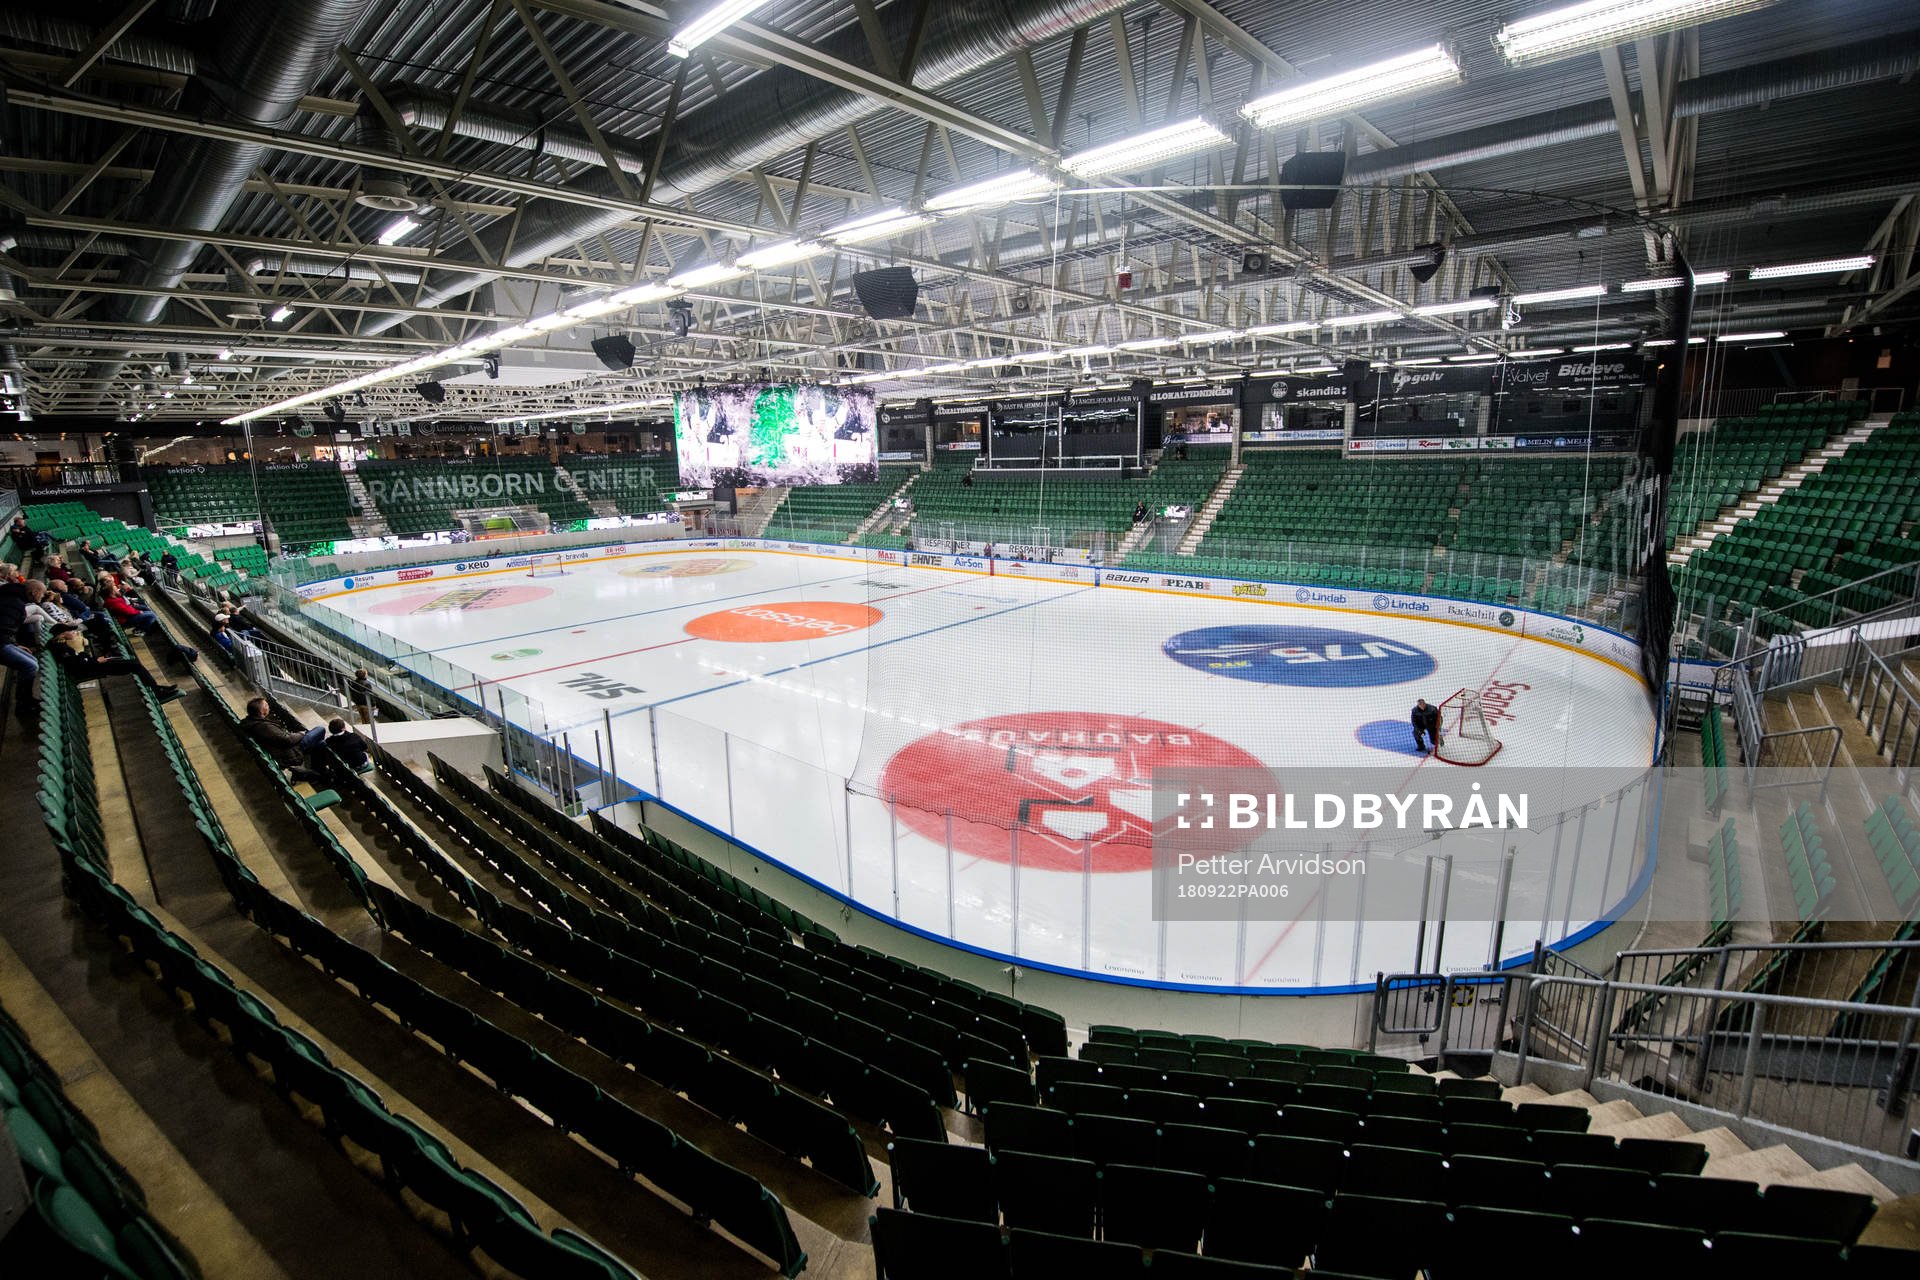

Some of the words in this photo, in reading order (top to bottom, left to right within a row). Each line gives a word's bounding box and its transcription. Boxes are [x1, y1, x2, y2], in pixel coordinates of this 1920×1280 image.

[1510, 368, 1550, 382] Valvet
[1558, 363, 1625, 377] Bildeve
[1157, 387, 1234, 401] LOKALTIDNINGEN
[437, 424, 465, 432] Lindab
[553, 466, 657, 493] CENTER
[351, 470, 545, 508] RÄNNBORN
[954, 557, 983, 569] AirSon
[1166, 578, 1205, 590] PEAB
[1312, 591, 1346, 604] Lindab
[1391, 598, 1430, 612] Lindab
[1447, 605, 1496, 621] Backahill
[730, 607, 861, 636] betsson
[1269, 641, 1421, 664] V75
[557, 672, 647, 700] SHL
[957, 727, 1193, 748] BAUHAUS
